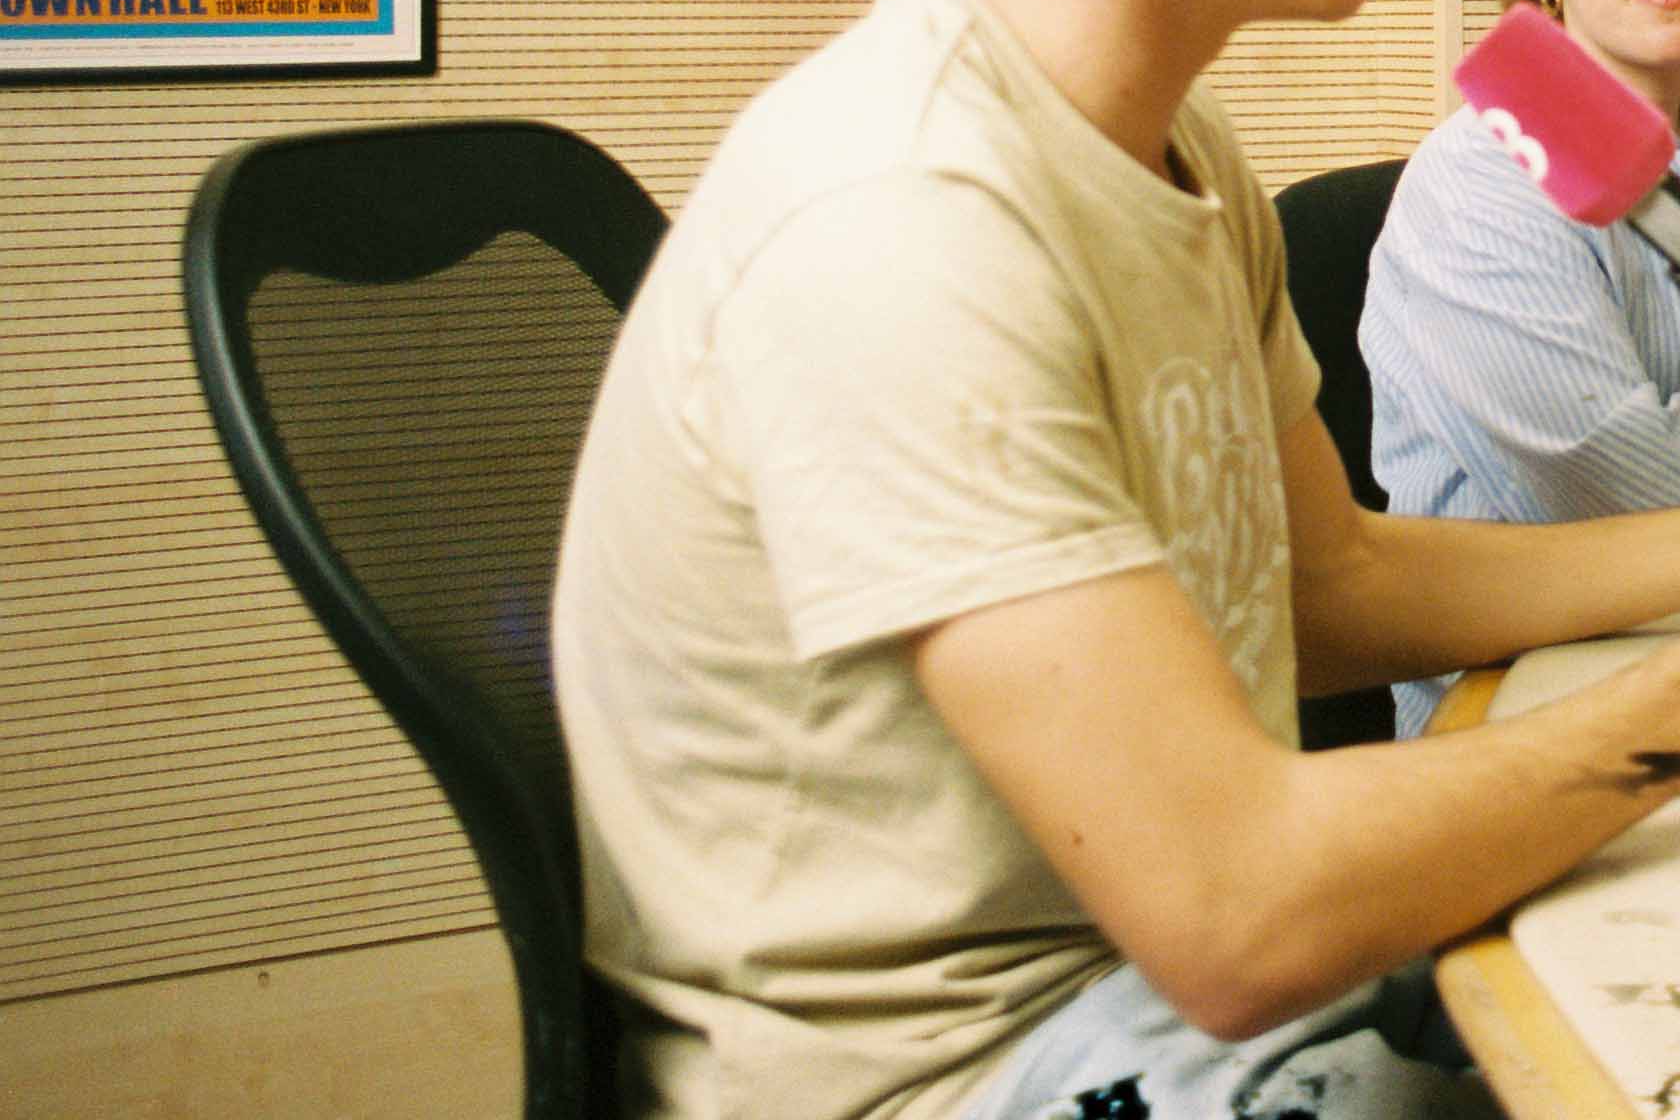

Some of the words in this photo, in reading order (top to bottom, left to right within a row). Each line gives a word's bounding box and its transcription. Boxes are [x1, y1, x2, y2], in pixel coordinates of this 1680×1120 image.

[235, 0, 265, 15] WEST
[297, 0, 310, 15] ST
[319, 0, 341, 14] NEW
[344, 0, 371, 14] YORK
